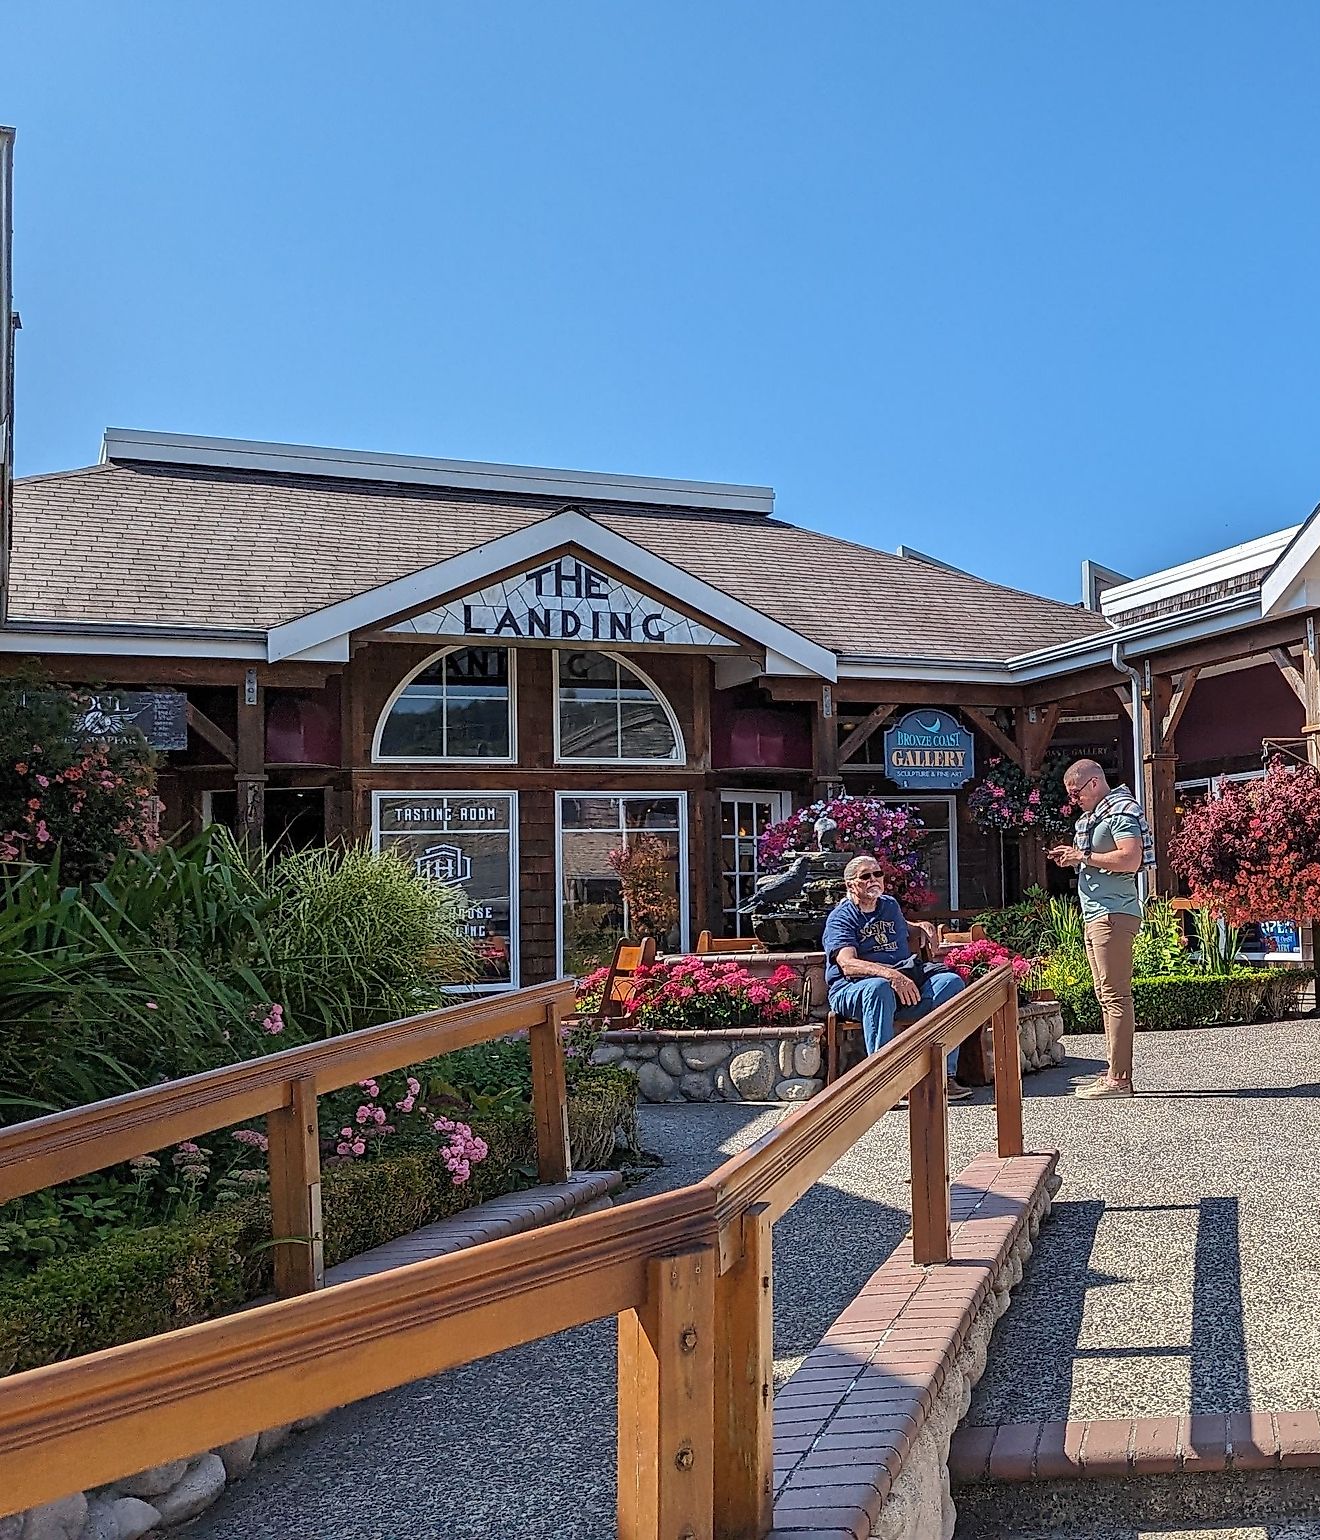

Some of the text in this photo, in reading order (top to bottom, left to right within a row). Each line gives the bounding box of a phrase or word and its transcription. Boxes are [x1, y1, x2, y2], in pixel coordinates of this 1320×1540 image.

[525, 561, 609, 600] THE
[464, 604, 666, 642] LANDING
[897, 731, 961, 747] BRONZE COAST
[891, 750, 966, 768] GALLERY
[395, 807, 496, 822] TASTING ROOM
